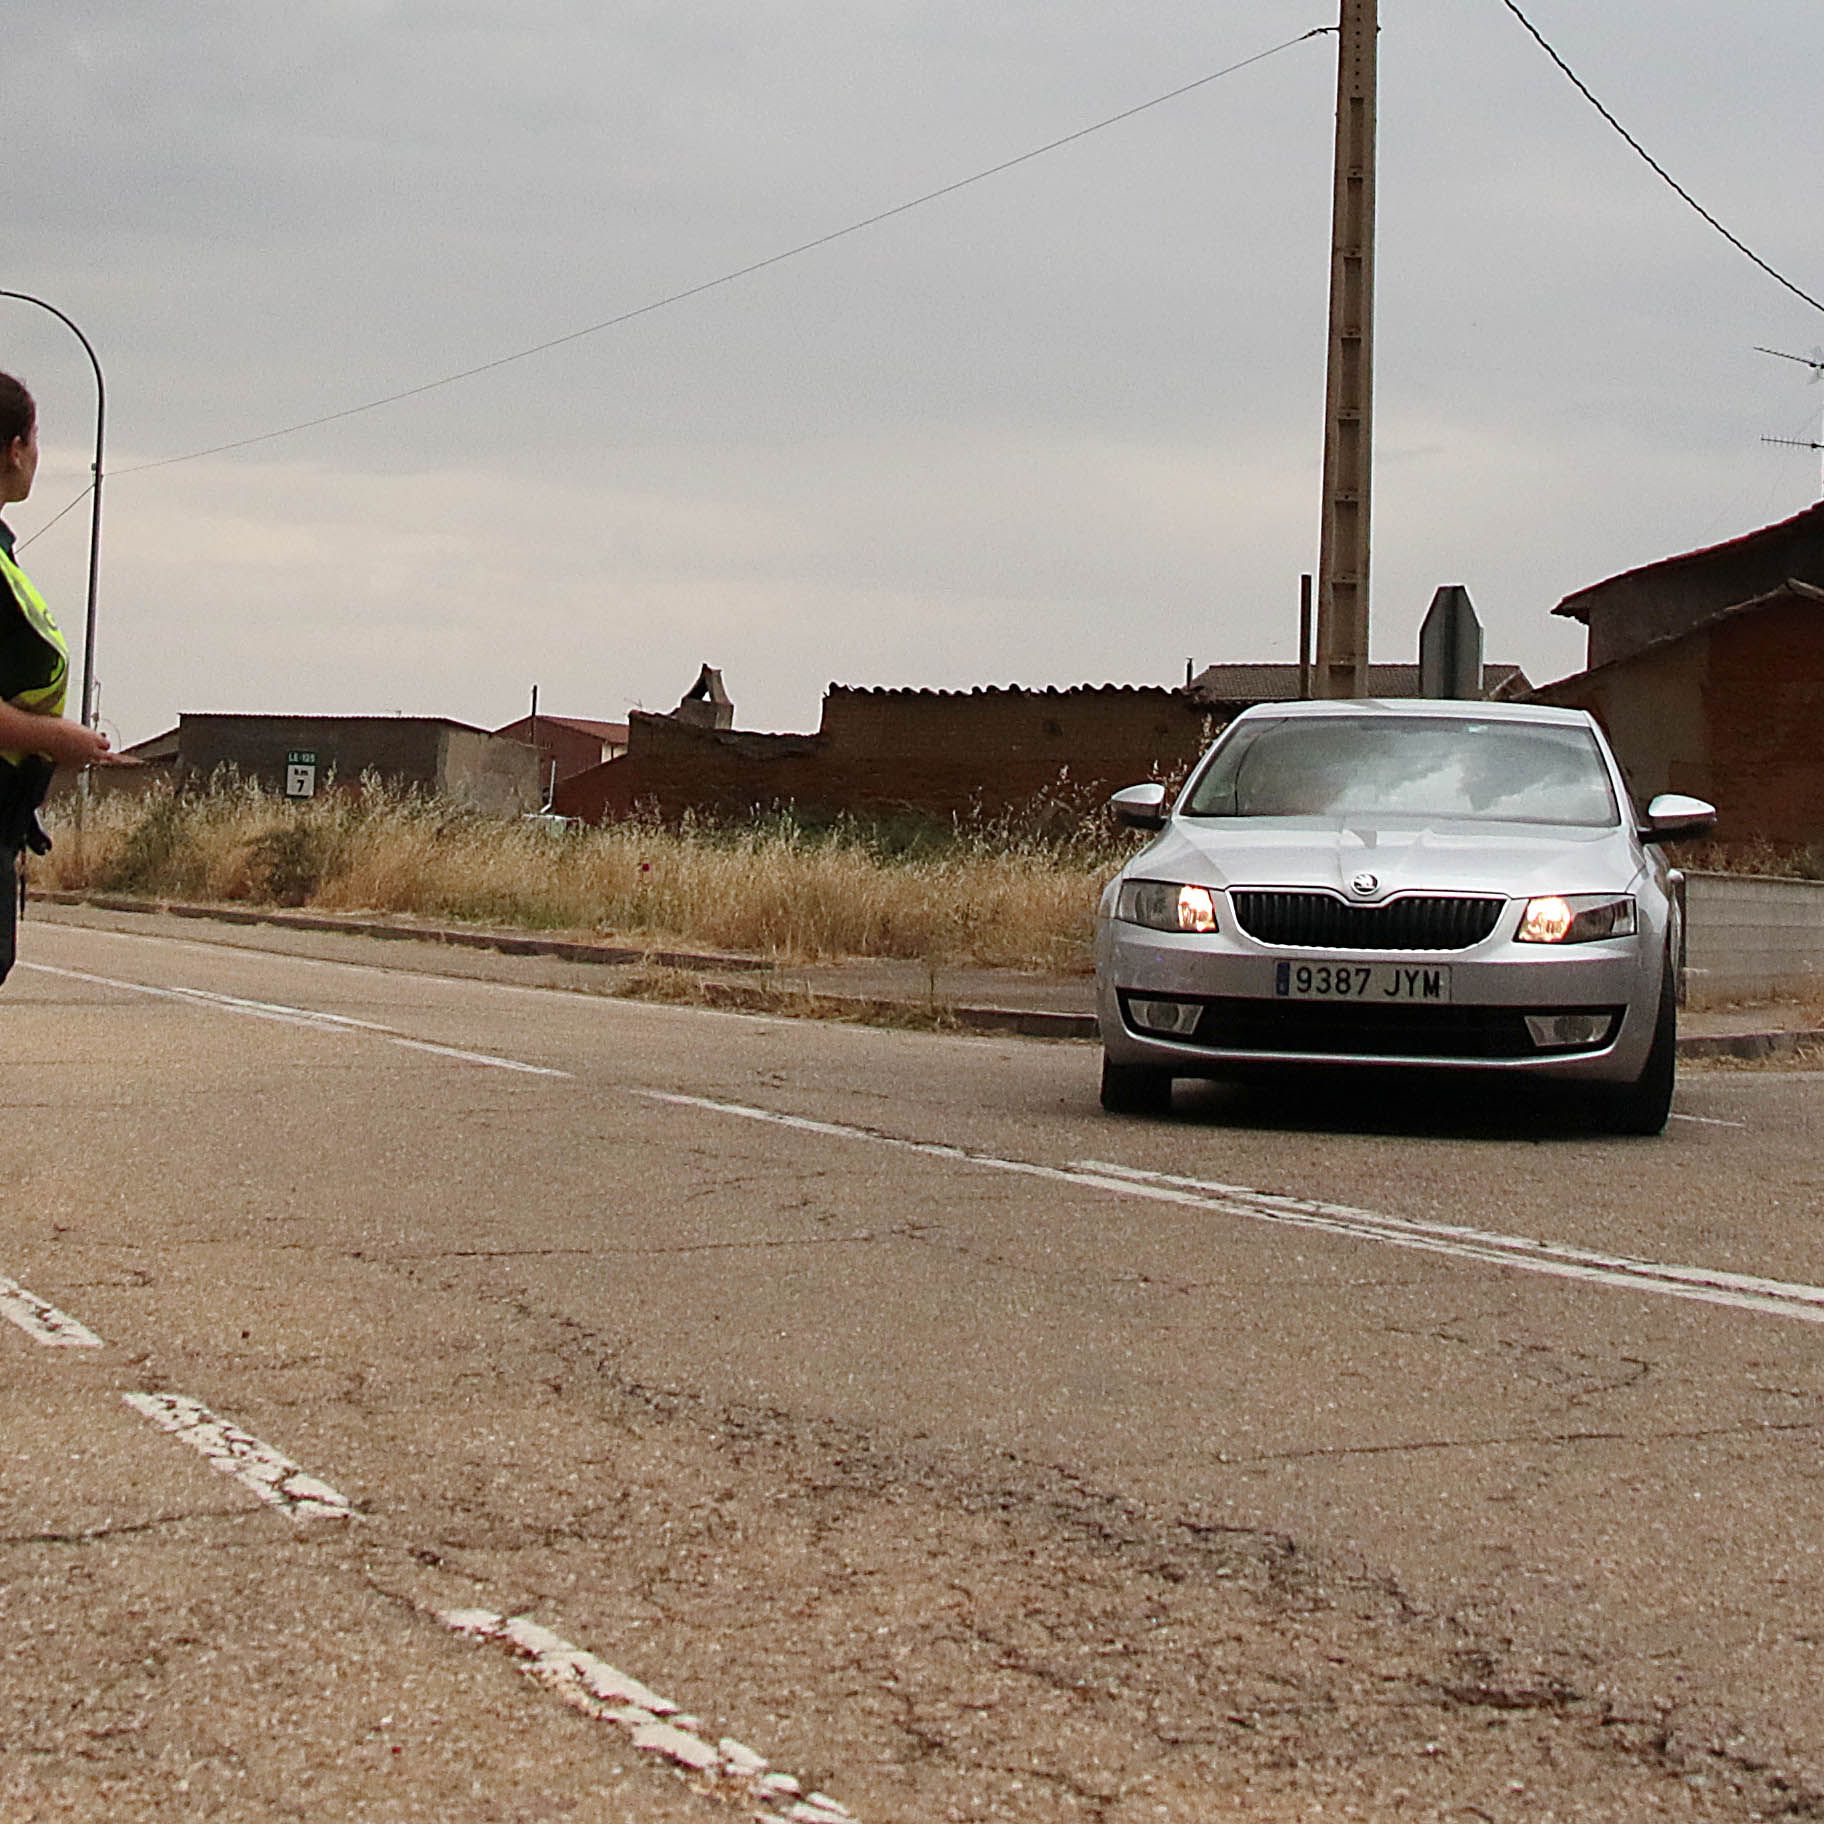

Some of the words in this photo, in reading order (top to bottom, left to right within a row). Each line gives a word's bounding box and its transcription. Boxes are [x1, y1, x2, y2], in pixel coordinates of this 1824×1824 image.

[297, 779, 304, 792] 7
[1296, 966, 1371, 995] 9387
[1384, 969, 1441, 998] JYM
